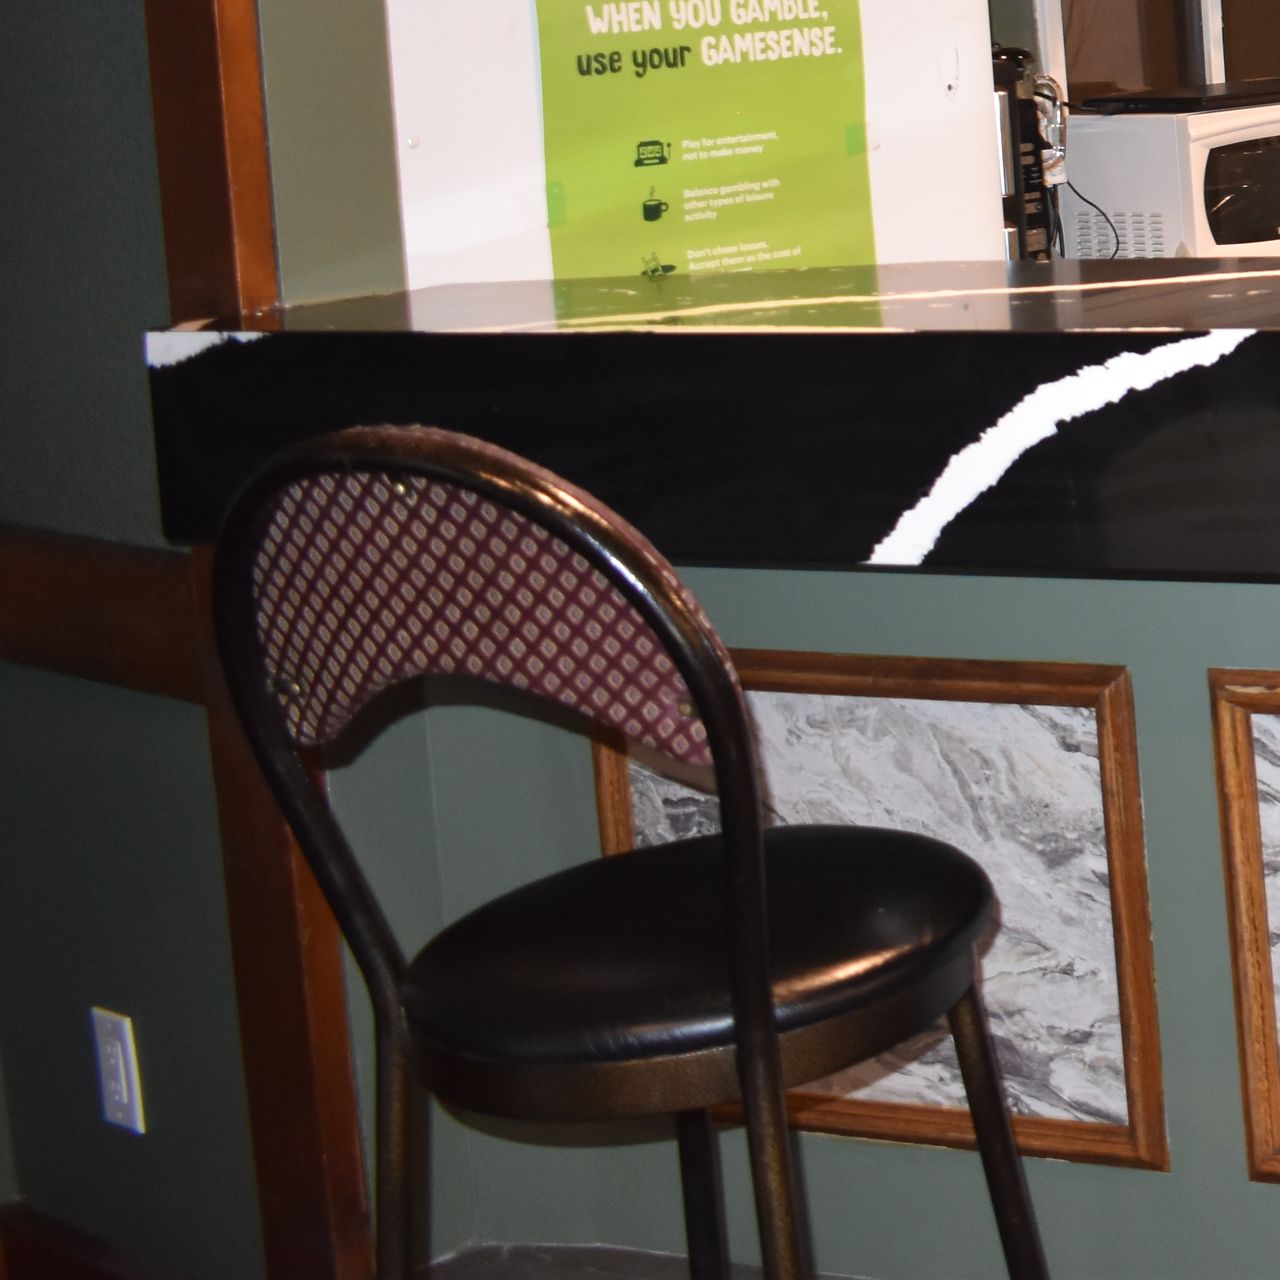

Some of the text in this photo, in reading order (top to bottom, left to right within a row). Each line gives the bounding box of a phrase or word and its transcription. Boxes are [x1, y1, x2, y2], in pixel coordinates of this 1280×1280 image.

[585, 0, 663, 35] WHEN
[576, 26, 844, 79] use your GAMESENSE.
[682, 131, 780, 150] Play for entertainment,
[682, 144, 764, 161] not to make money
[684, 177, 781, 199] Balance gambling with
[684, 190, 775, 211] other types of leisure
[684, 210, 717, 222] activity
[687, 247, 711, 259] Don't
[713, 244, 738, 256] chase
[689, 258, 721, 271] Accept
[721, 255, 746, 266] them
[757, 250, 772, 261] the
[772, 248, 791, 259] cost
[792, 245, 802, 256] of
